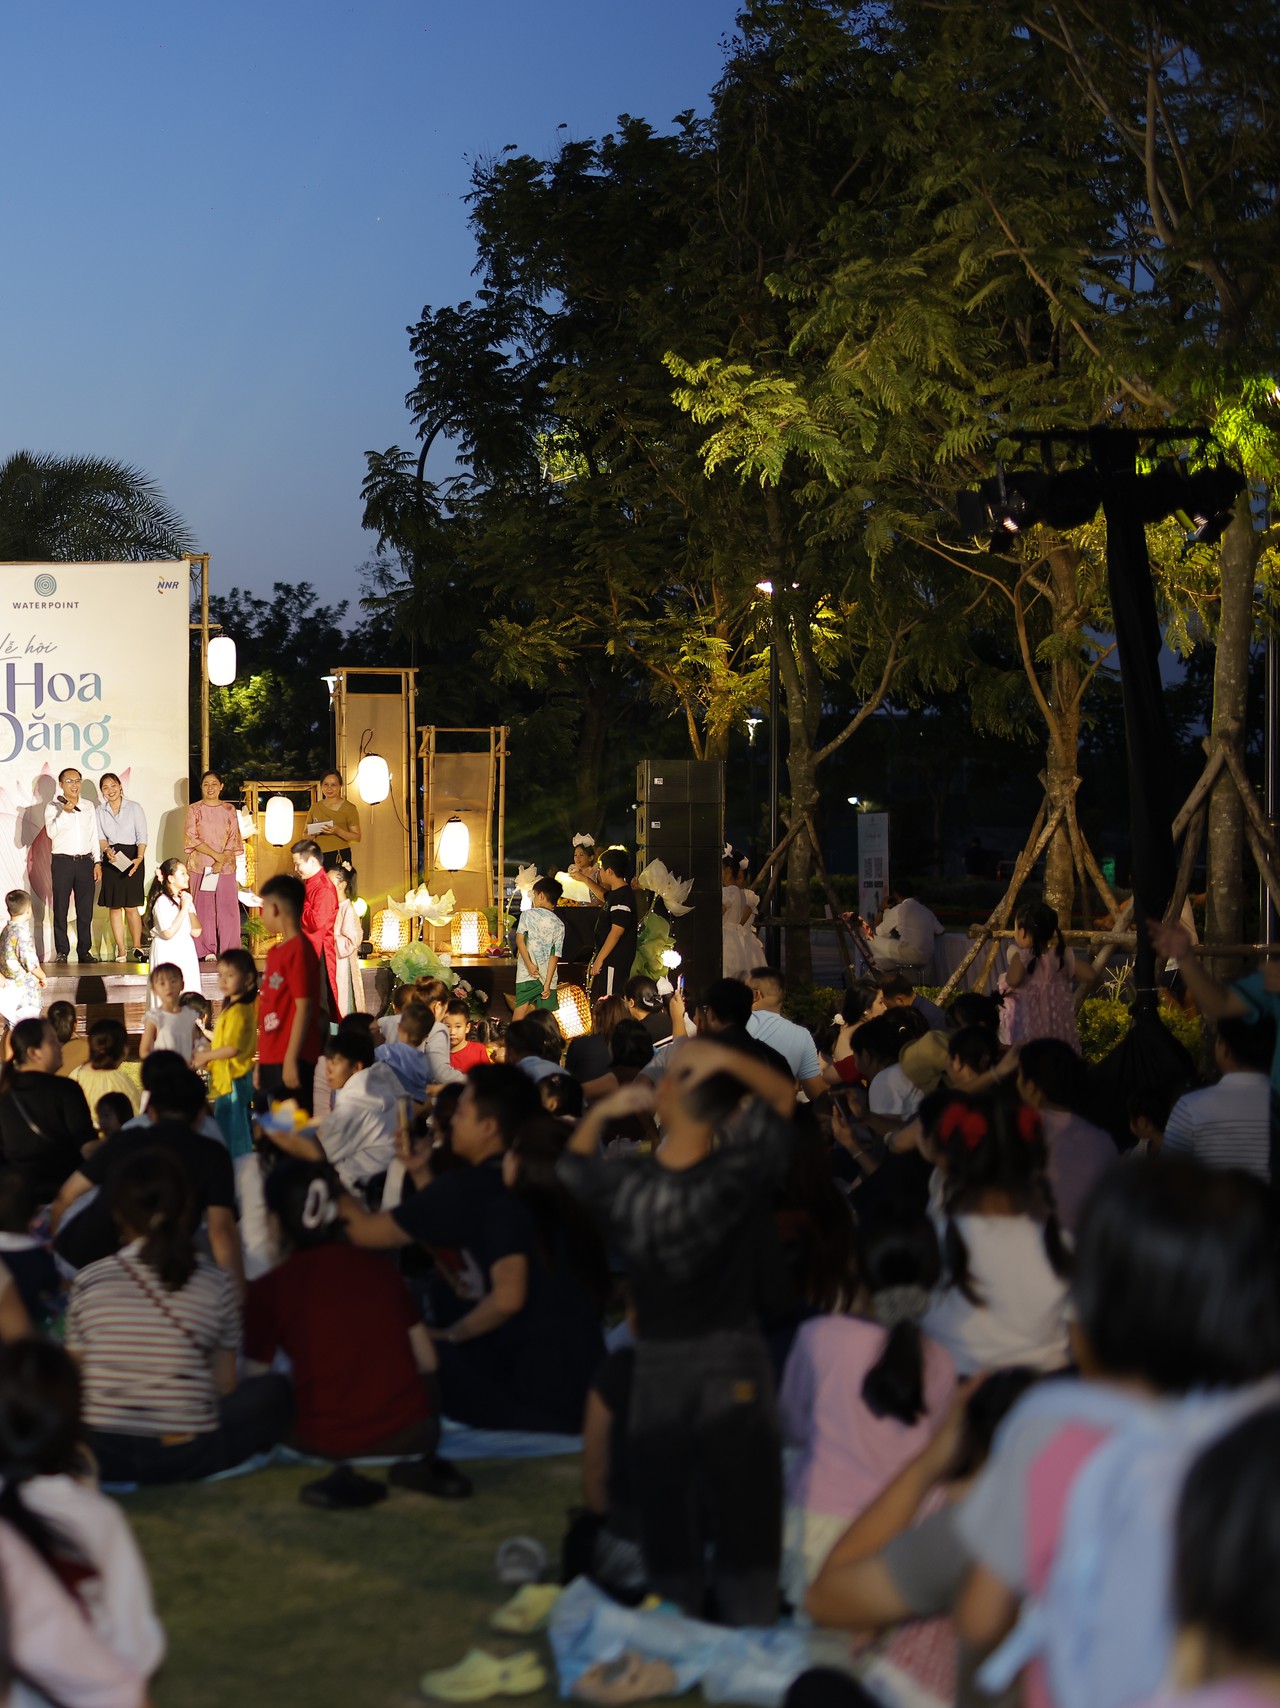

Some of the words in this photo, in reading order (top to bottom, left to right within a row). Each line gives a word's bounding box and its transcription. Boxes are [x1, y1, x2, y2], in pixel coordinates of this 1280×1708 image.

[157, 581, 180, 589] NNR
[12, 601, 80, 609] WATERPOINT
[24, 634, 58, 655] hội
[6, 662, 102, 714] Hoa
